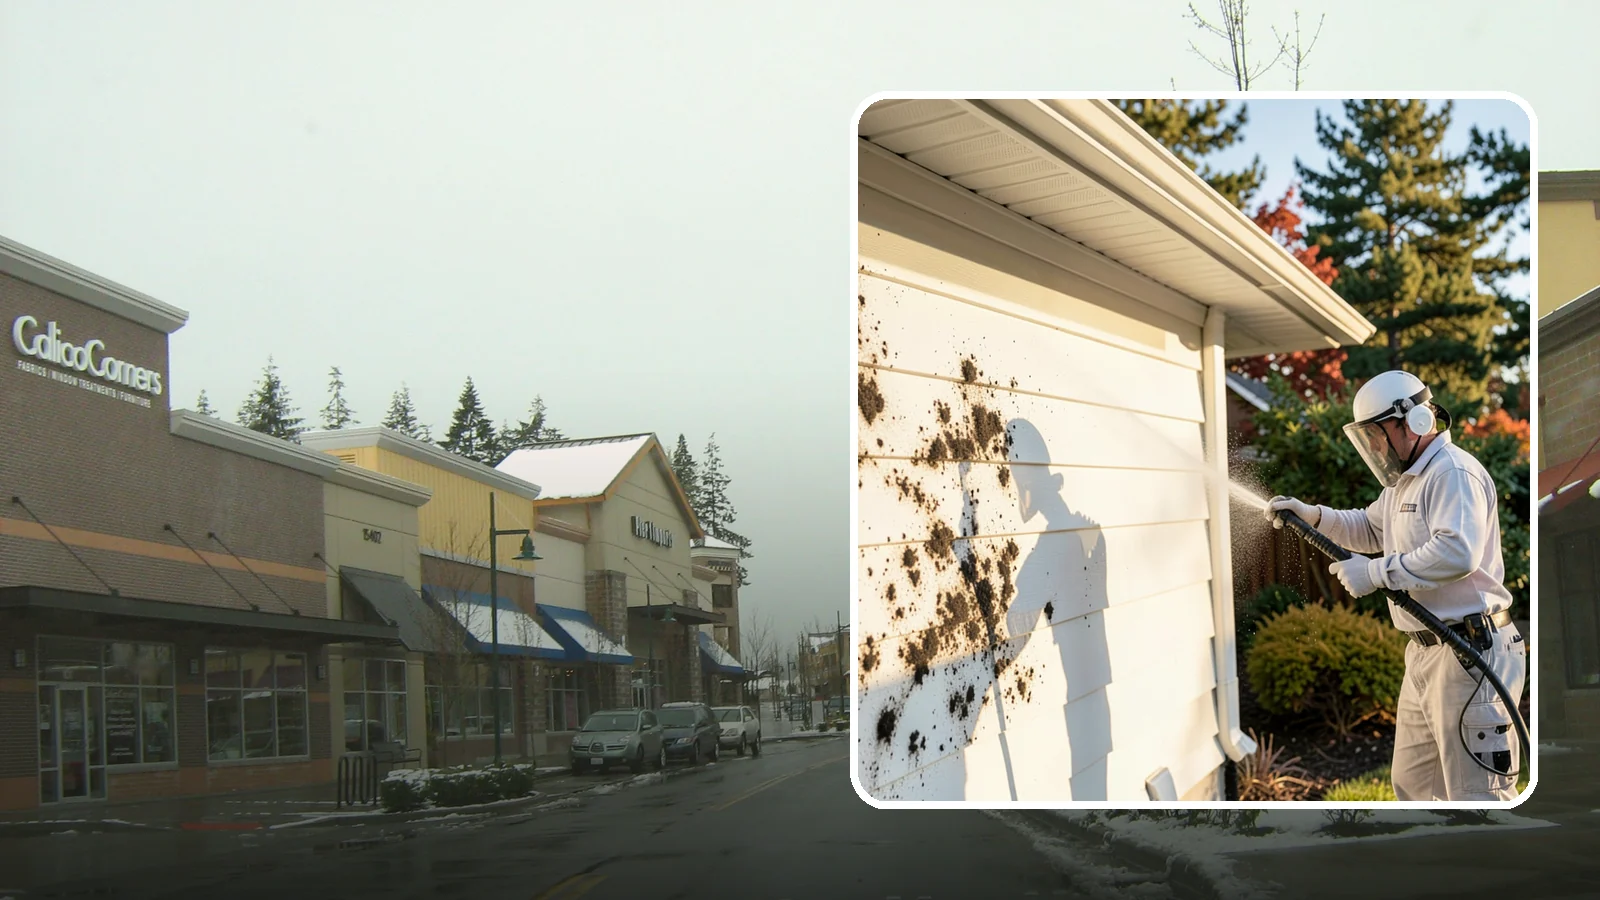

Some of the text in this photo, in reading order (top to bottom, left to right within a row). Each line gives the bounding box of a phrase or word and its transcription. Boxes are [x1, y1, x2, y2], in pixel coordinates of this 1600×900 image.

[12, 315, 162, 395] CalicoCorners
[17, 360, 47, 378] FABRICS
[51, 370, 79, 387] WINDOW
[78, 378, 117, 399] TREATMENTS
